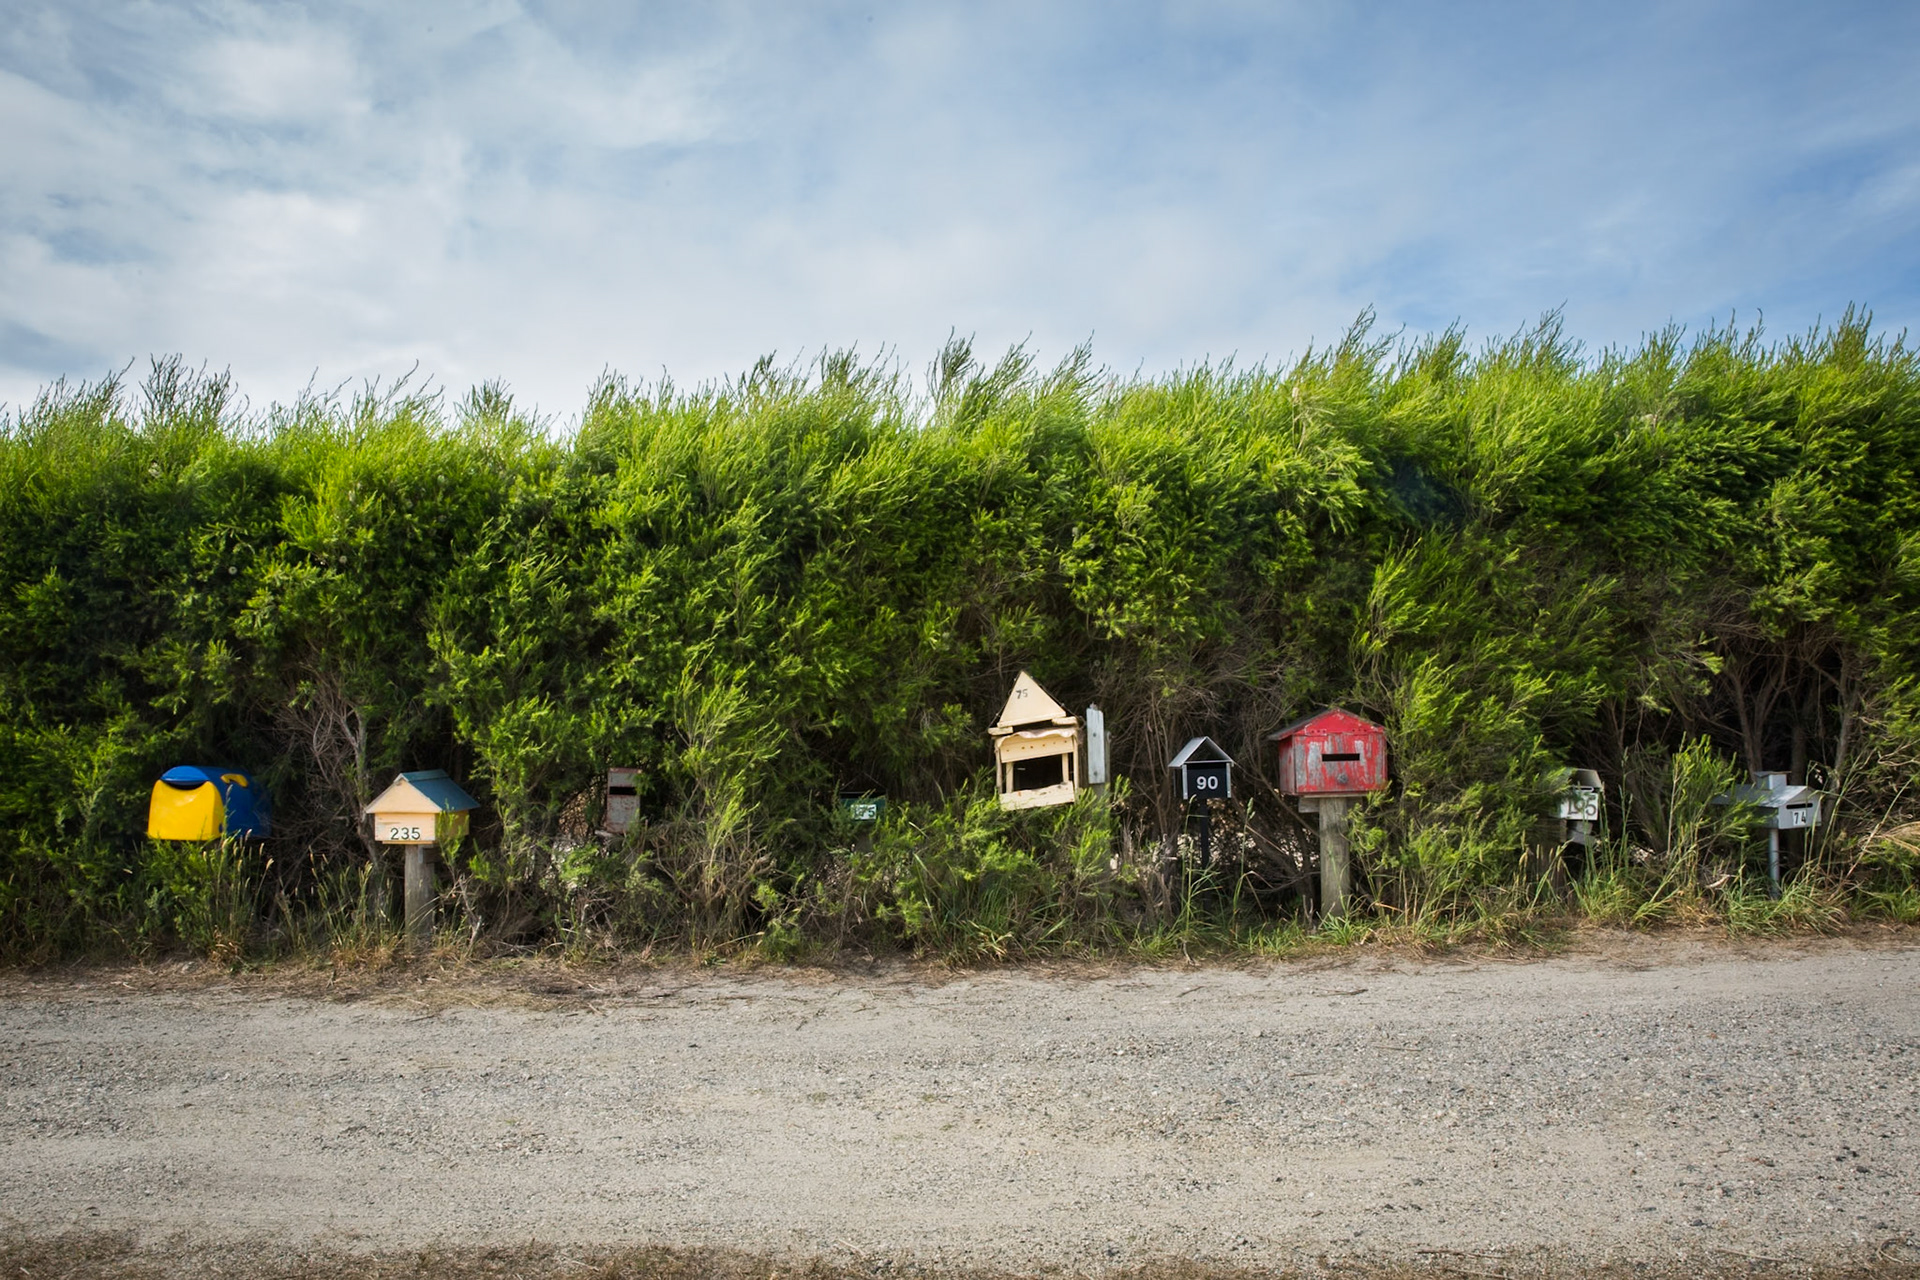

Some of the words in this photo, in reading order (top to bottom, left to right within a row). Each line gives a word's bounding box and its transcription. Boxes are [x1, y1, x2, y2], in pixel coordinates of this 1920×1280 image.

[1015, 689, 1028, 699] 75
[1196, 775, 1219, 790] 90
[1794, 811, 1807, 824] 74
[390, 827, 421, 840] 235
